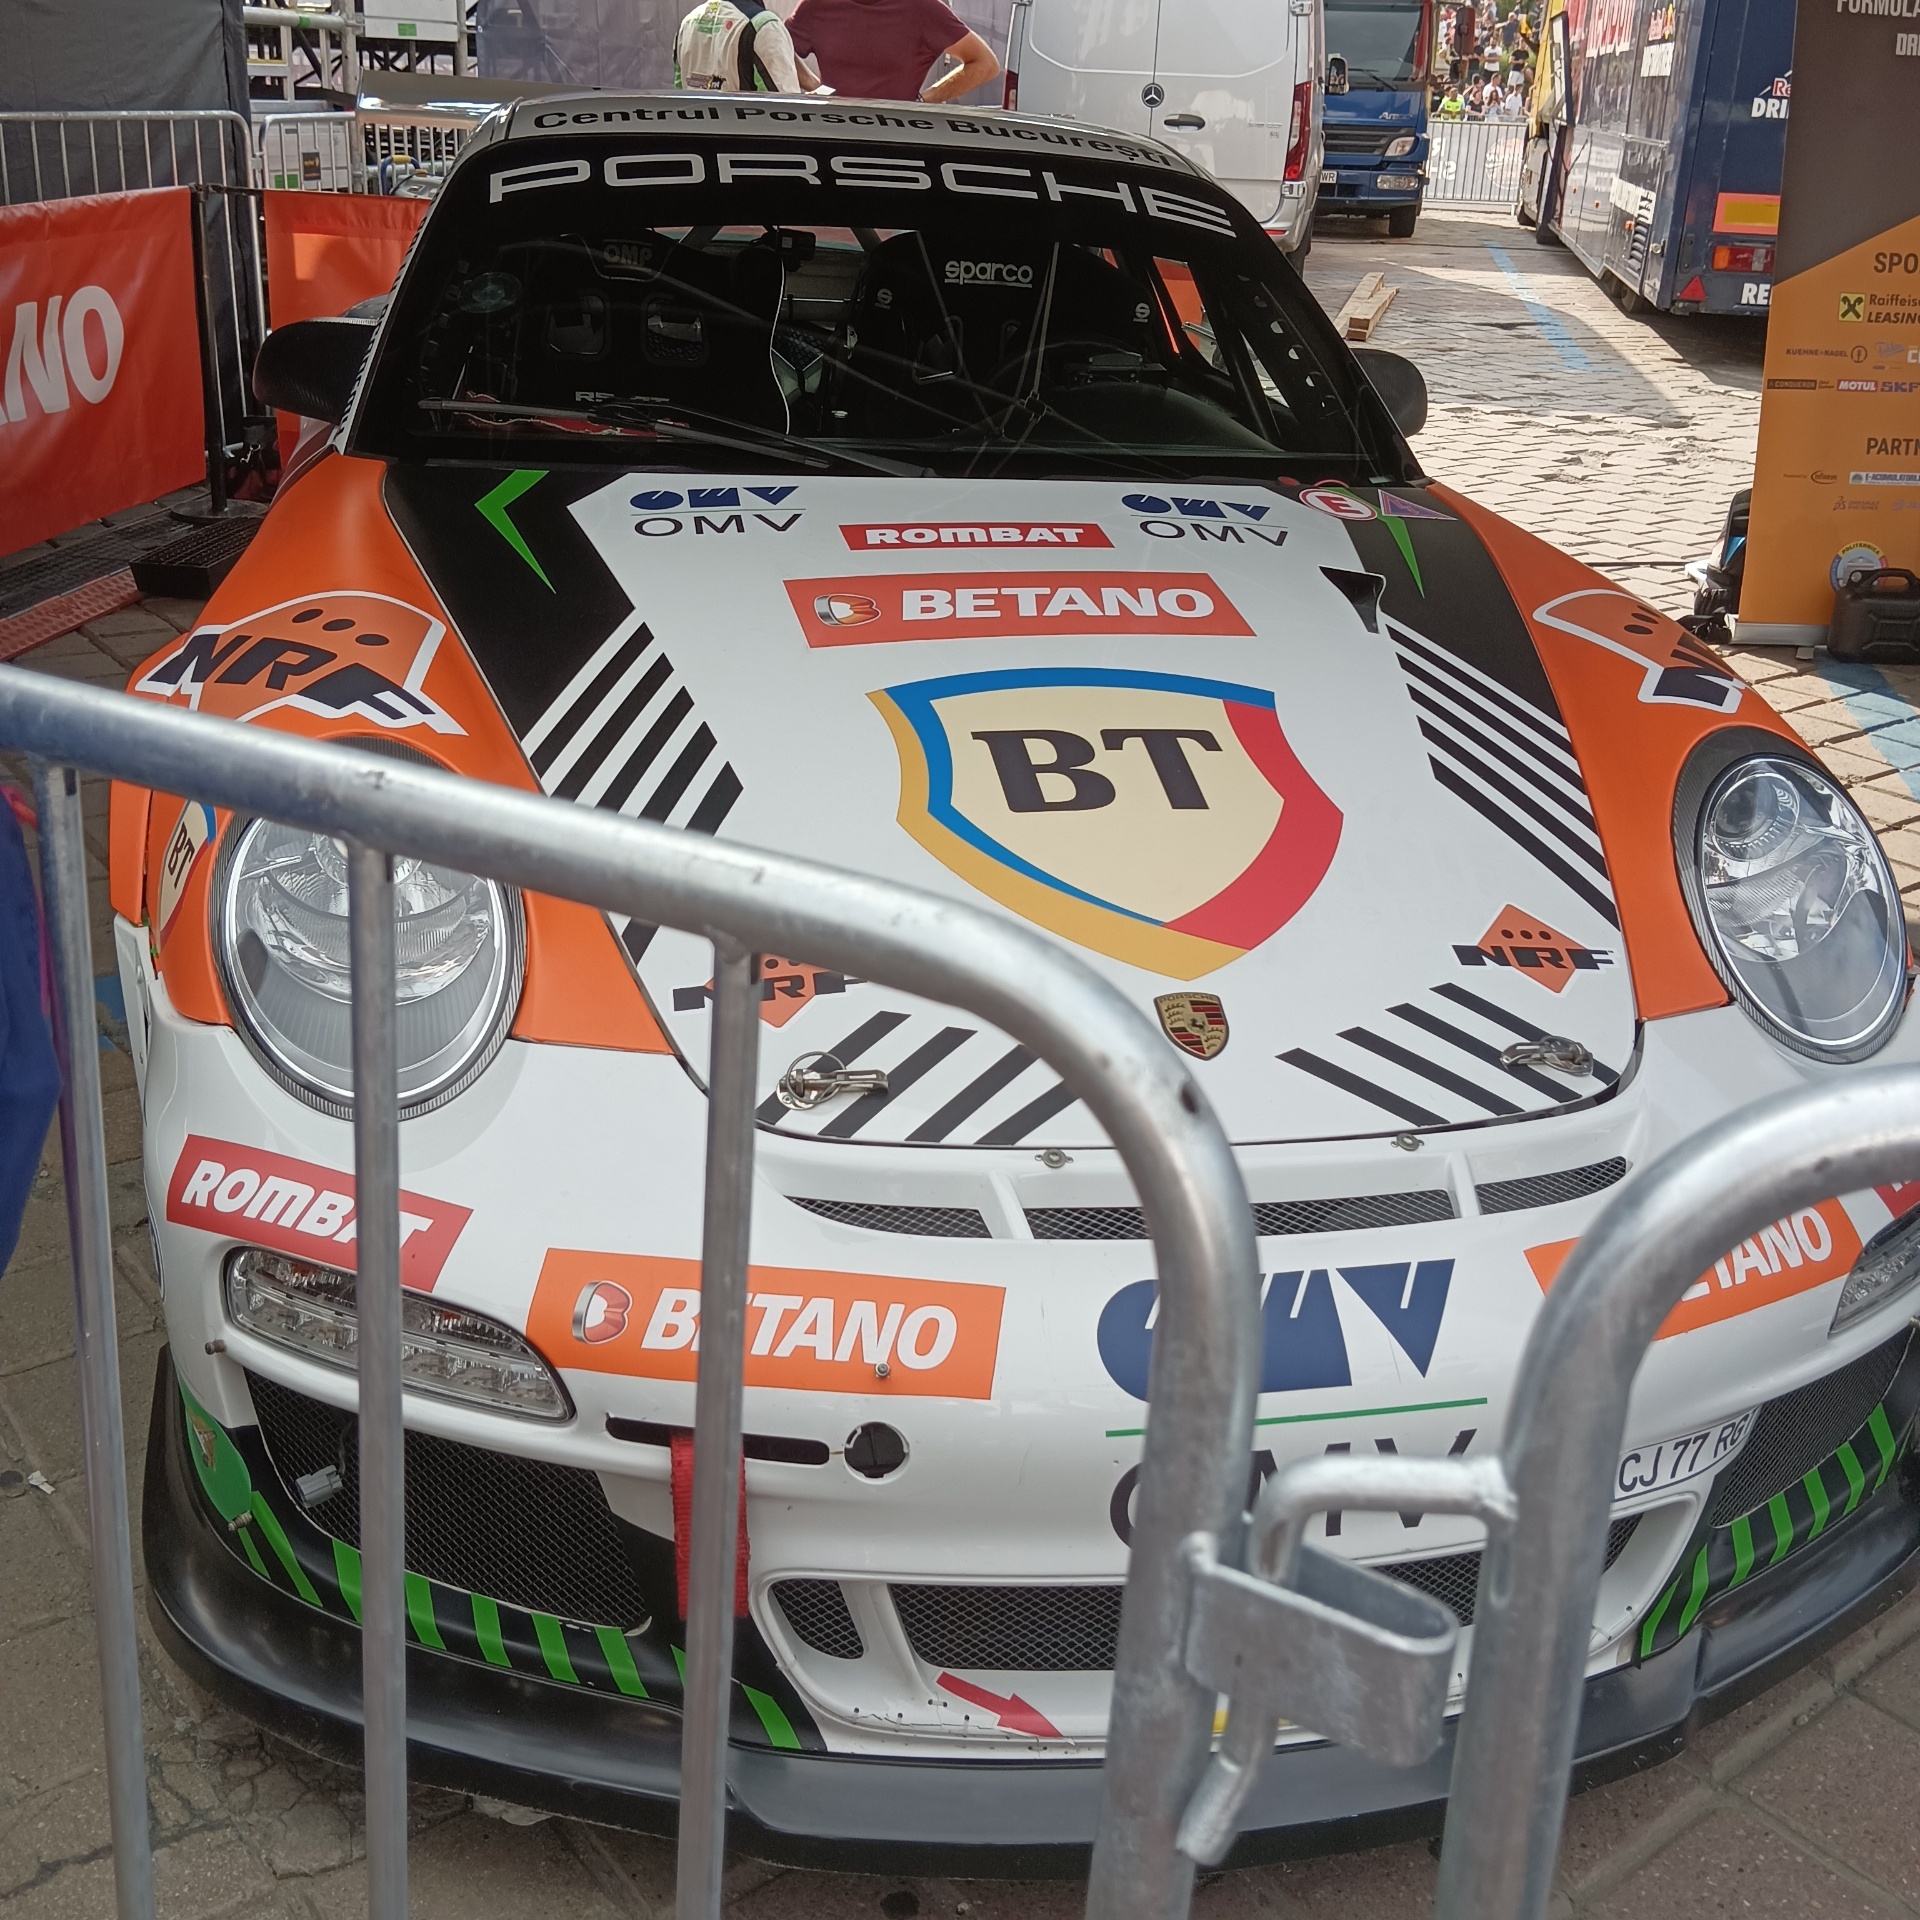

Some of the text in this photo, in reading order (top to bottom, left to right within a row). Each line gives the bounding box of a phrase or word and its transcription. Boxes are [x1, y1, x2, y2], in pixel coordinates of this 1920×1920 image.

[1751, 97, 1789, 119] DRI
[534, 107, 1173, 167] Centrul Porsche București
[490, 153, 1237, 238] PORSCHE
[603, 244, 652, 266] OMP
[1873, 252, 1920, 274] SPO
[945, 260, 1033, 287] sparco
[1741, 283, 1772, 305] RE
[0, 285, 125, 426] NO
[1838, 380, 1876, 391] MOTUL
[634, 513, 802, 536] OMV
[865, 527, 1084, 545] ROMBAT
[1139, 520, 1288, 547] OMV
[902, 587, 1215, 621] BETANO
[970, 728, 1223, 813] BT
[167, 821, 195, 889] BT
[1452, 944, 1615, 970] NRF
[1158, 993, 1217, 1004] PORSCHE
[181, 1159, 435, 1251] ROMBT
[641, 1287, 958, 1370] BTANO
[1619, 1446, 1663, 1492] CJ
[1670, 1431, 1710, 1479] 77
